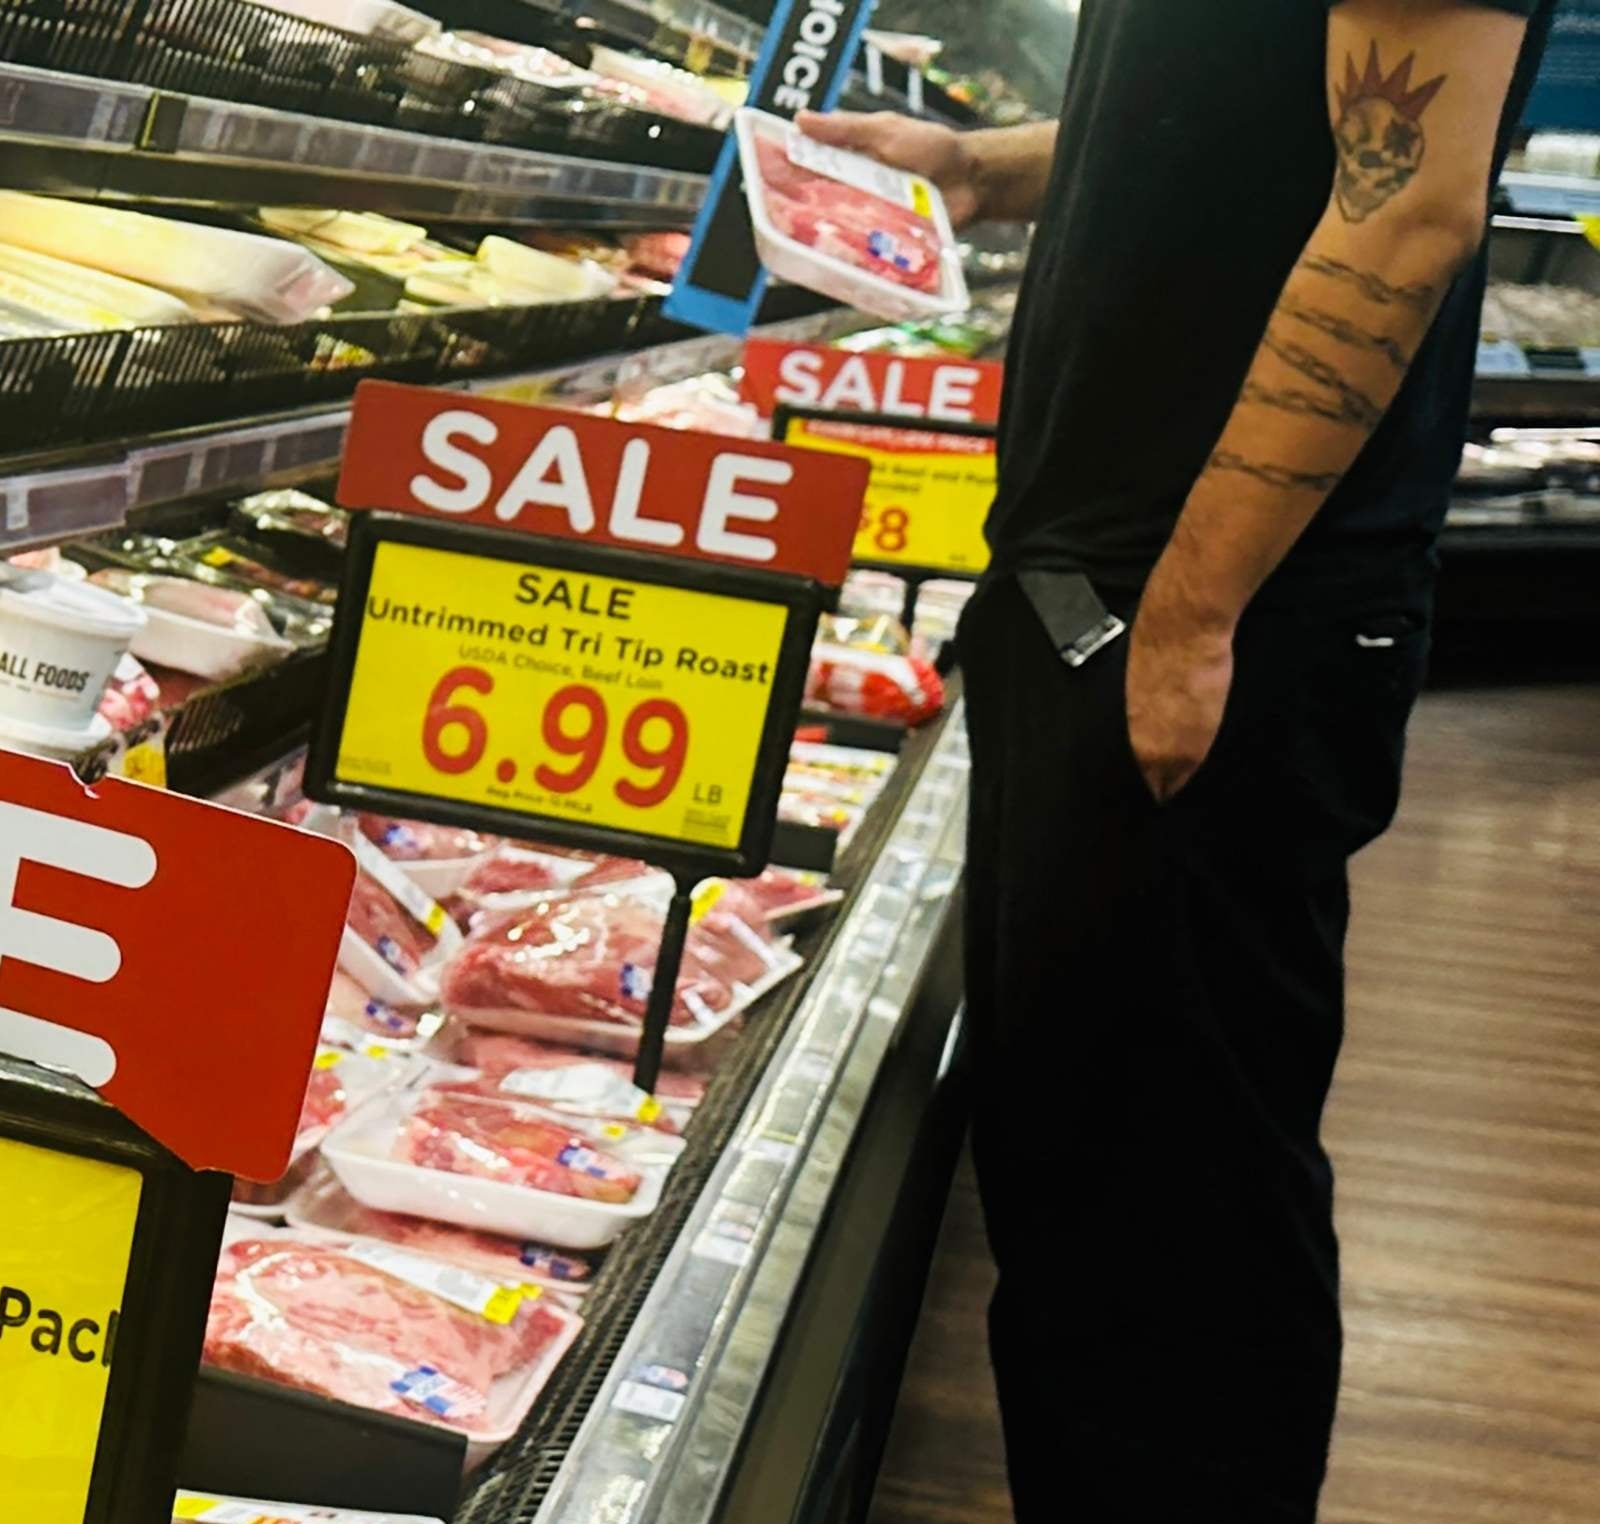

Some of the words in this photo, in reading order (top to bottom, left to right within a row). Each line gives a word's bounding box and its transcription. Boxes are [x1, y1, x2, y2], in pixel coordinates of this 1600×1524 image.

[774, 350, 982, 422] SALE
[409, 410, 795, 562] SALE
[515, 572, 637, 621] SALE
[366, 596, 548, 647] Untrimmed
[561, 626, 603, 656] Tri
[615, 637, 665, 669] Tip
[676, 648, 770, 685] Roast
[33, 661, 91, 693] FOODS
[421, 665, 691, 810] 6.99
[692, 782, 725, 806] LB
